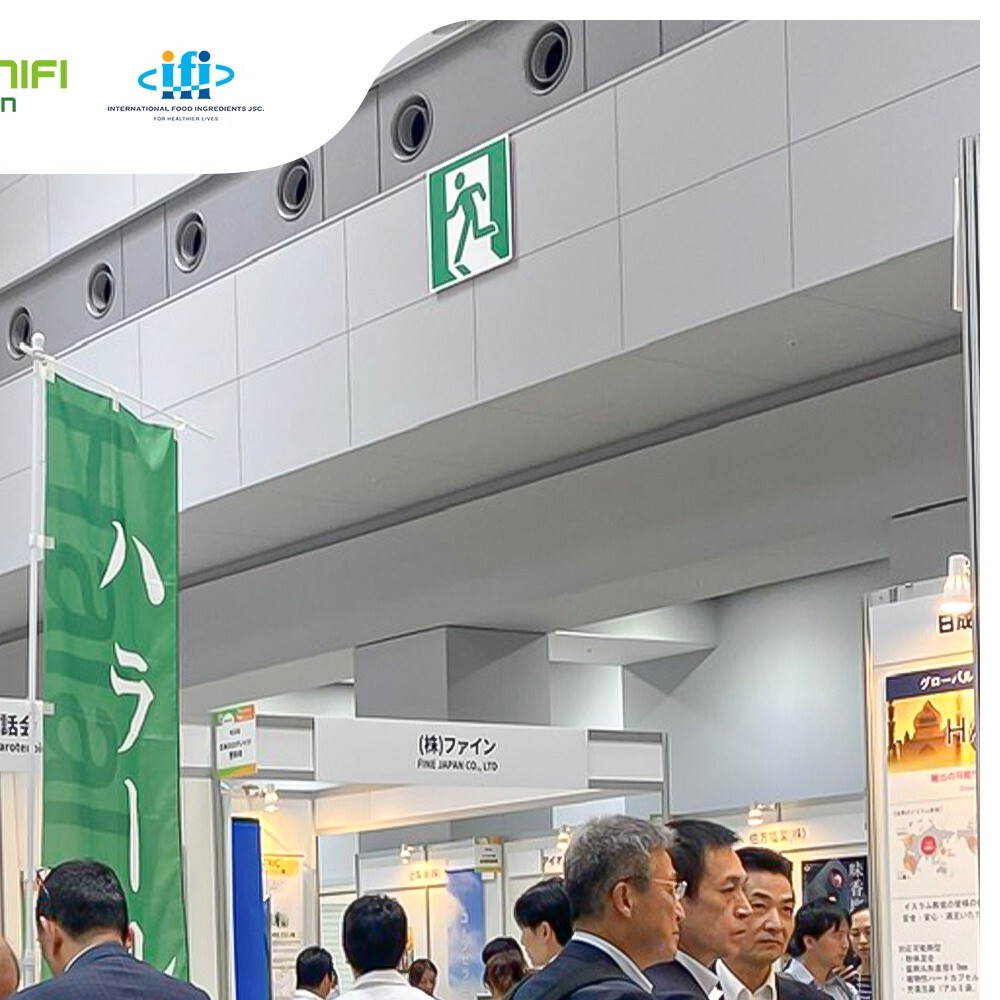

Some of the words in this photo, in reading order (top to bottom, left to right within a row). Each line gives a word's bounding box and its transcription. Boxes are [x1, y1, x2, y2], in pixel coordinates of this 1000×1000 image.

[418, 734, 497, 757] (株)ファイン
[417, 758, 437, 769] FINE
[438, 759, 465, 770] JAPAN
